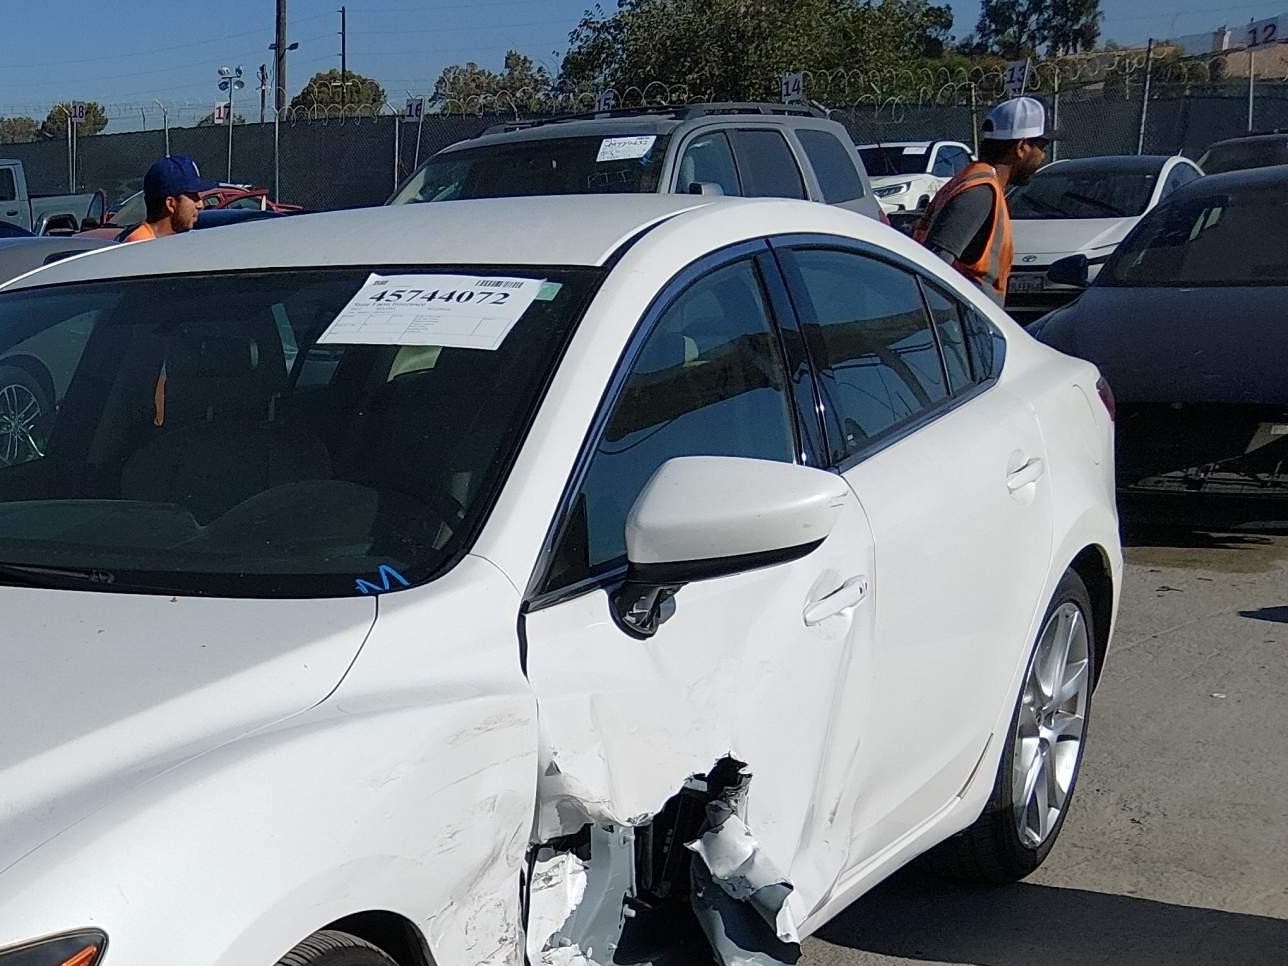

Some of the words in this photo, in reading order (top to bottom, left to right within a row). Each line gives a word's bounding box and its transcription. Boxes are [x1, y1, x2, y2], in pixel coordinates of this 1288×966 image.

[1247, 23, 1277, 49] 12
[783, 78, 801, 97] 14
[71, 104, 85, 119] 18
[368, 288, 511, 306] 45744072
